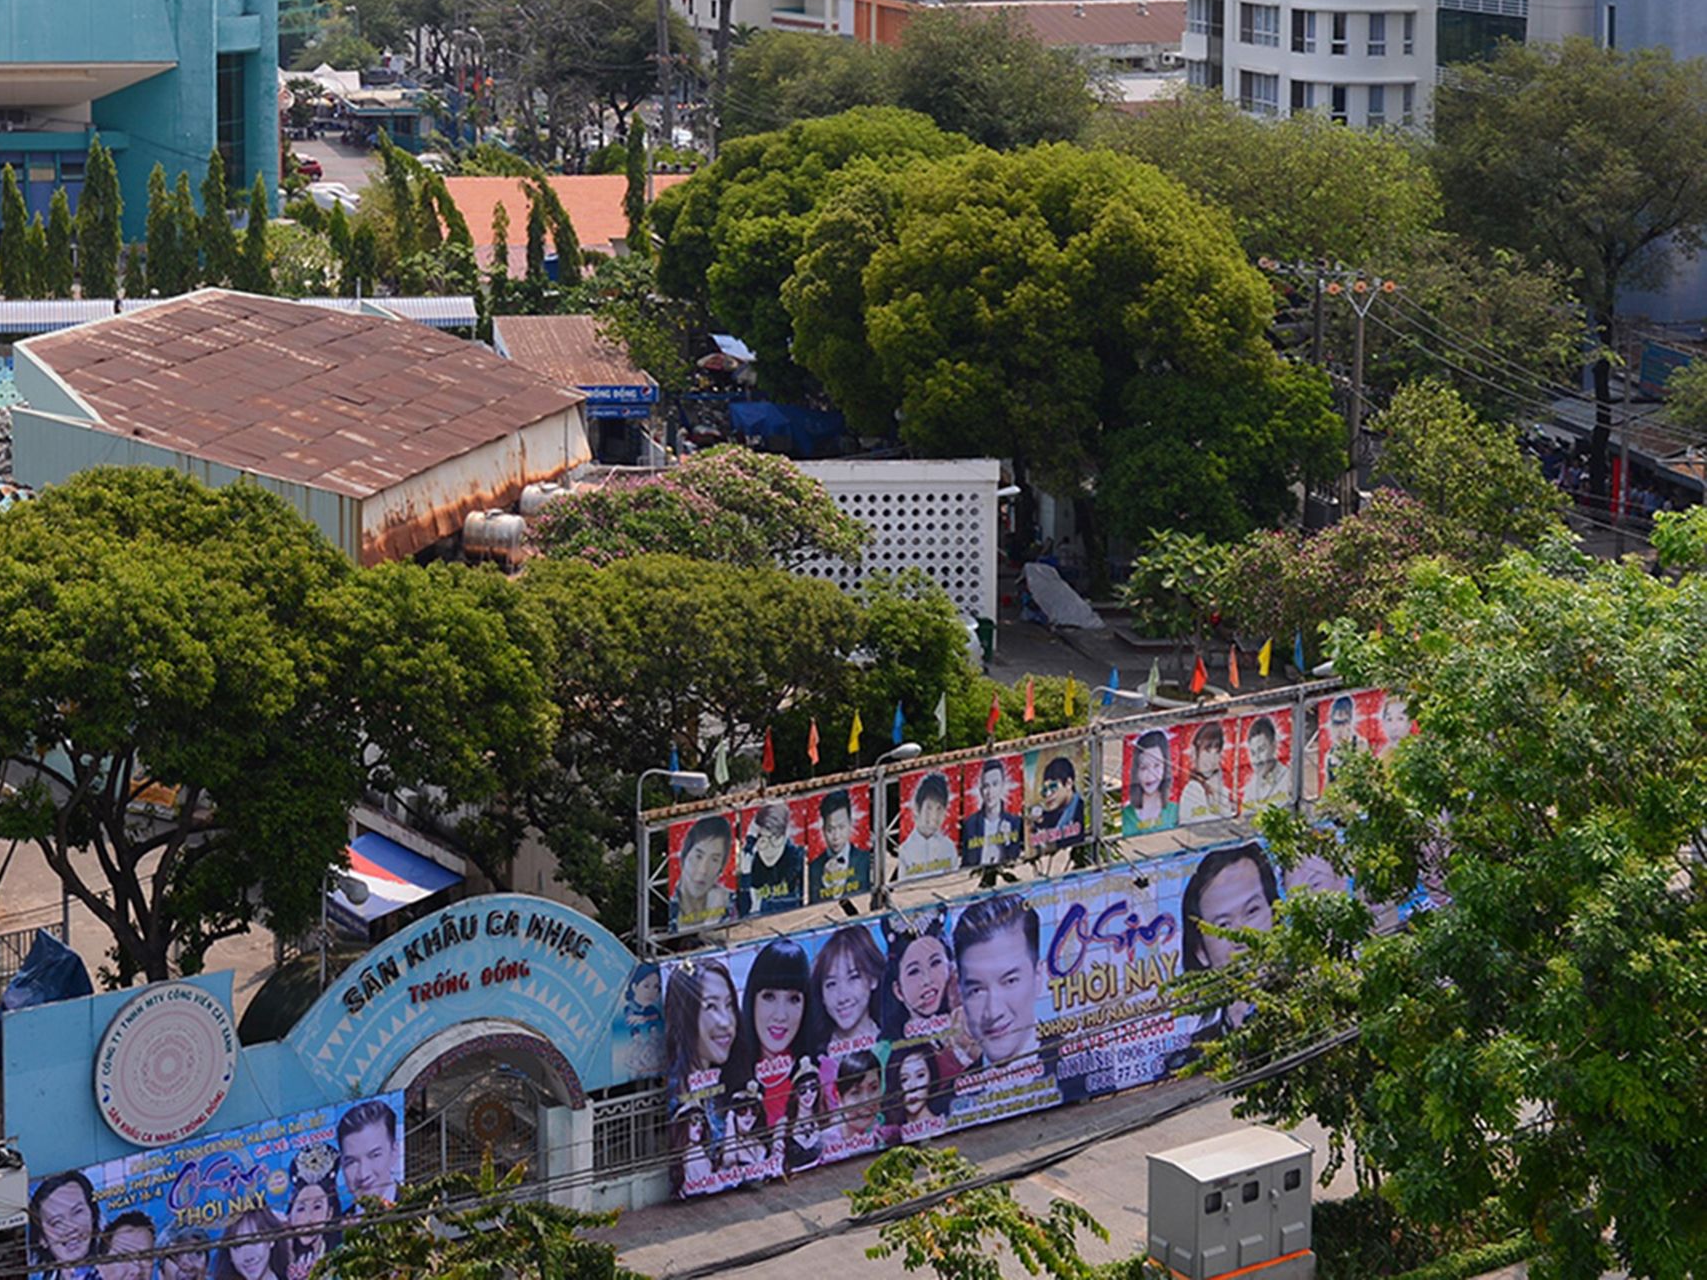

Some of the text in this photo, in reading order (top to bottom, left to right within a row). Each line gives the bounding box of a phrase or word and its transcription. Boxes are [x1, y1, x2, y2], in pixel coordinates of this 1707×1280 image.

[342, 956, 401, 1014] SÂN
[485, 909, 520, 938] CA
[525, 913, 594, 961] NHẠC
[1124, 951, 1180, 996] NAY
